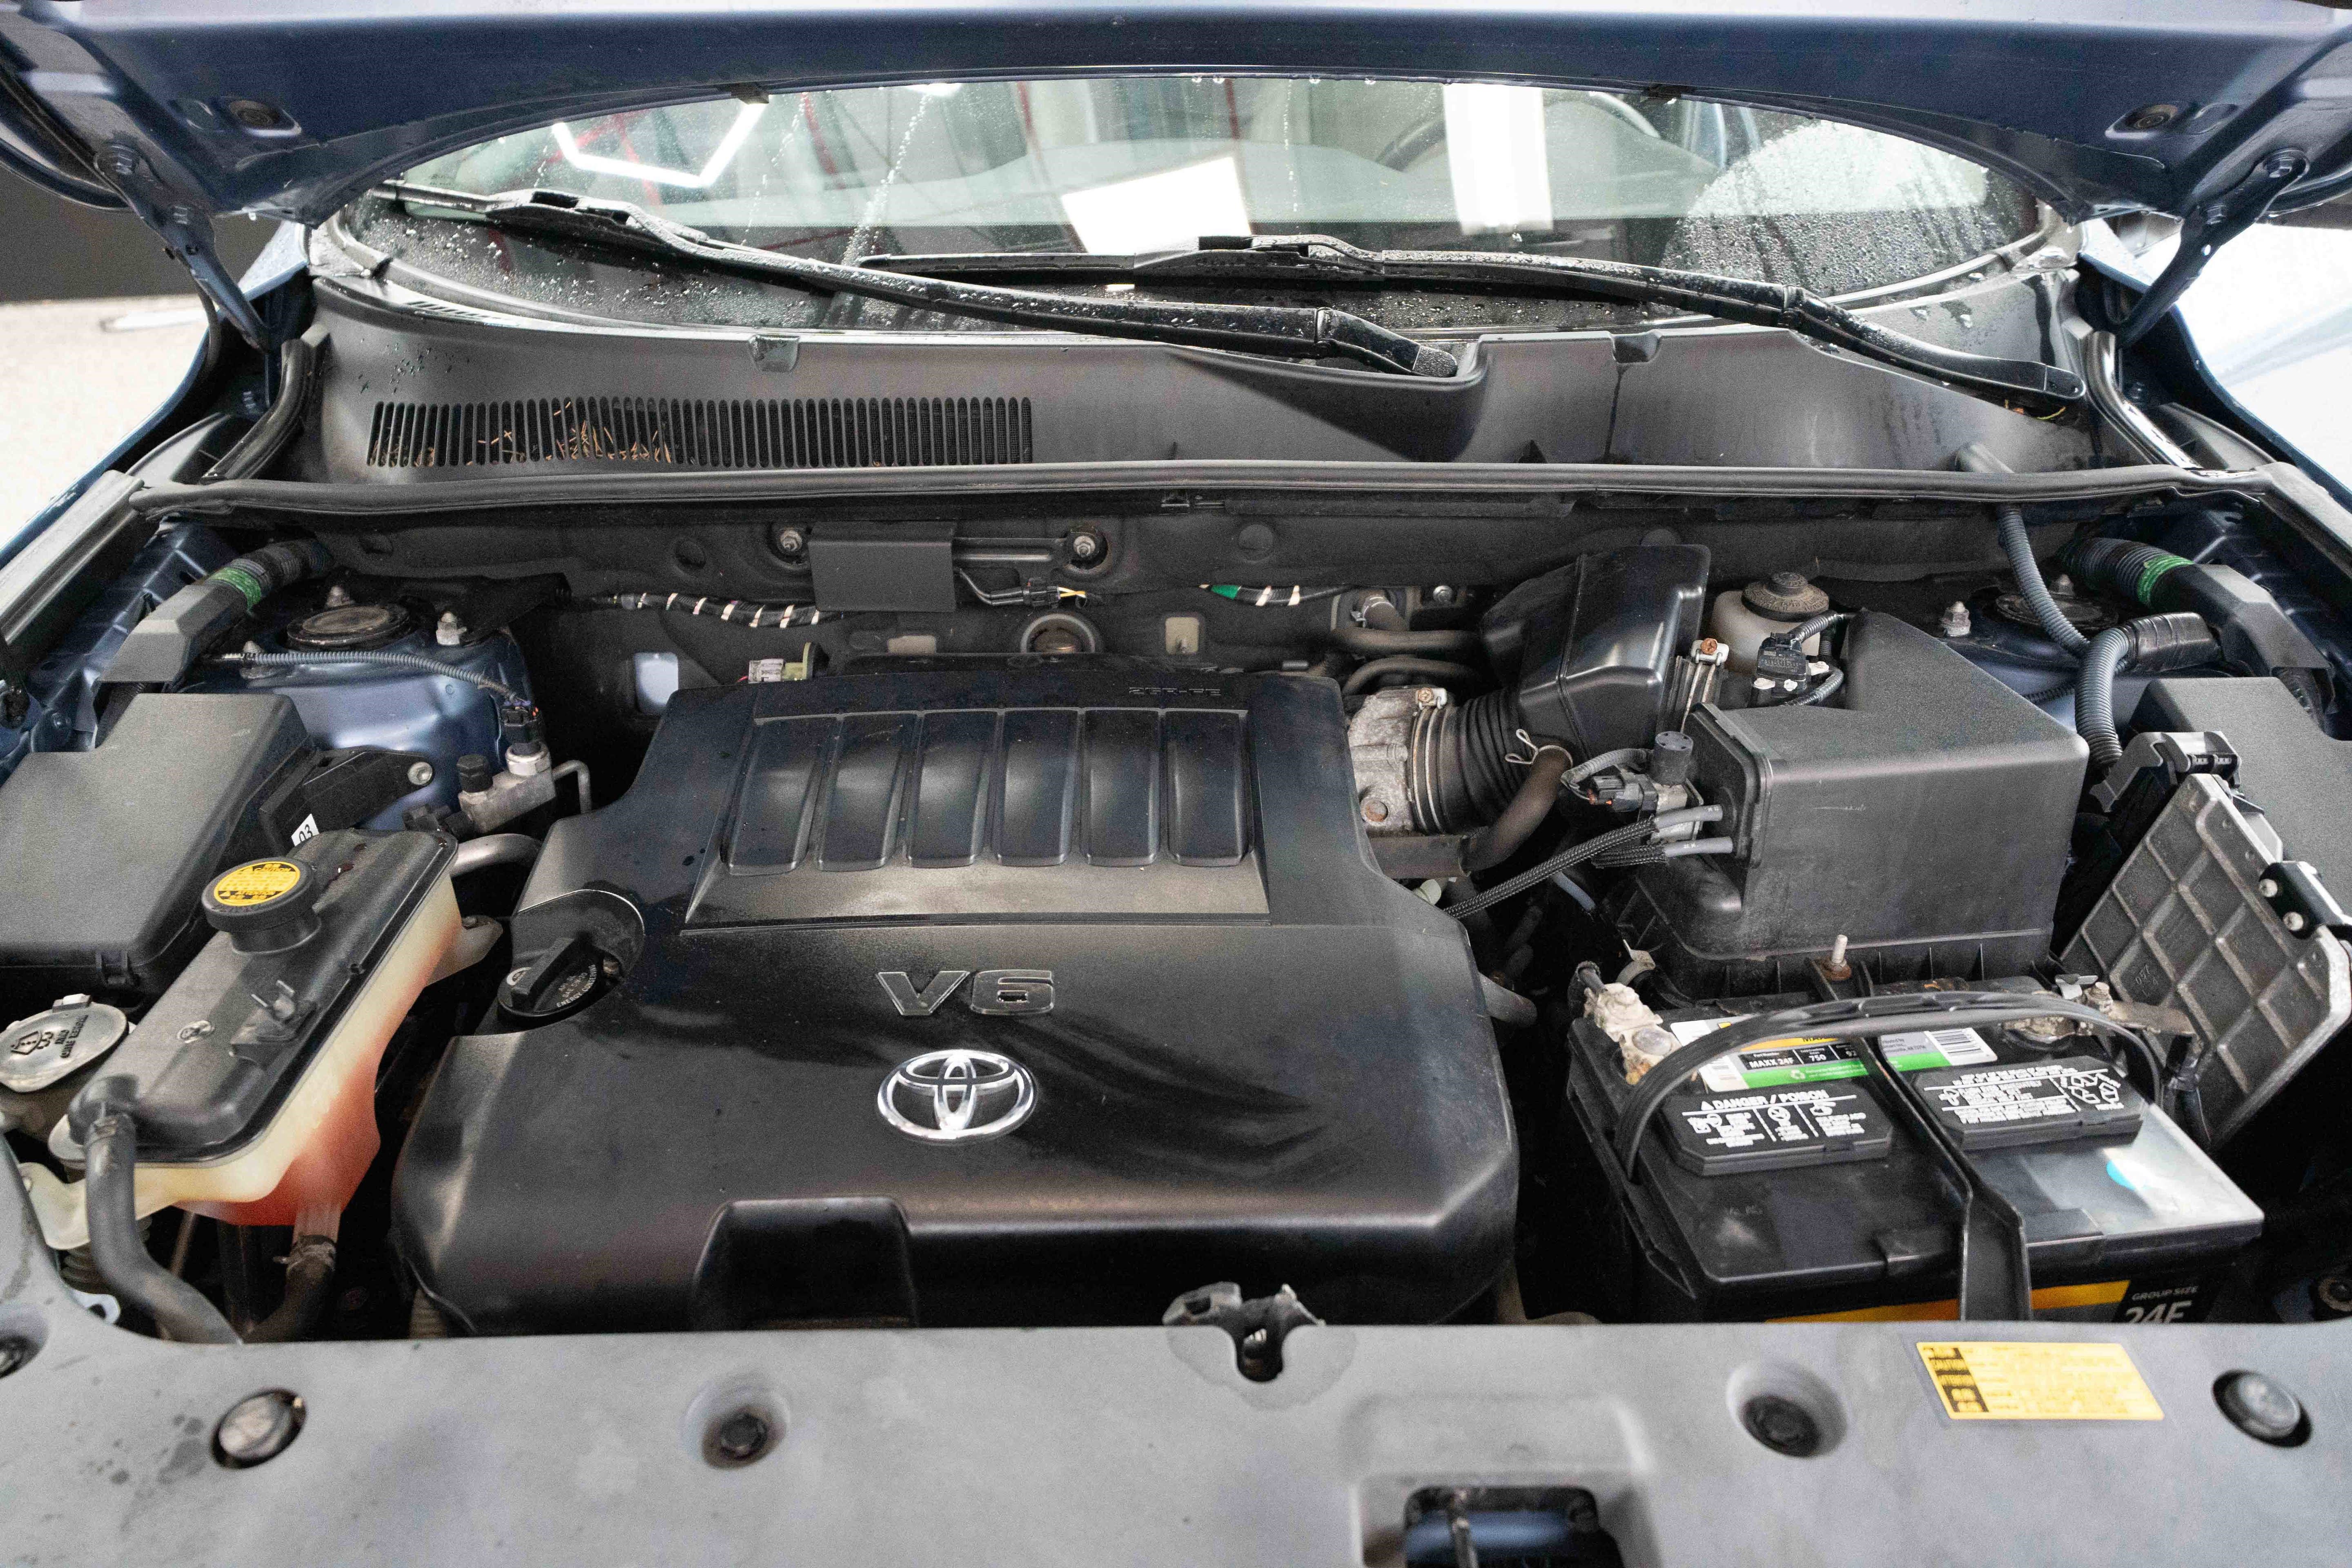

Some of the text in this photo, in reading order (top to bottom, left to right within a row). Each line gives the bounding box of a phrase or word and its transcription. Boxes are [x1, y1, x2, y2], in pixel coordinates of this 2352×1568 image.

[556, 964, 597, 1007] ENERGY CONSERVING
[876, 969, 1055, 1016] V6
[1748, 1059, 1778, 1069] MAXX
[1712, 1096, 1768, 1109] DANGER
[1777, 1089, 1829, 1102] POISON
[2132, 1286, 2198, 1301] GROUP SIZE
